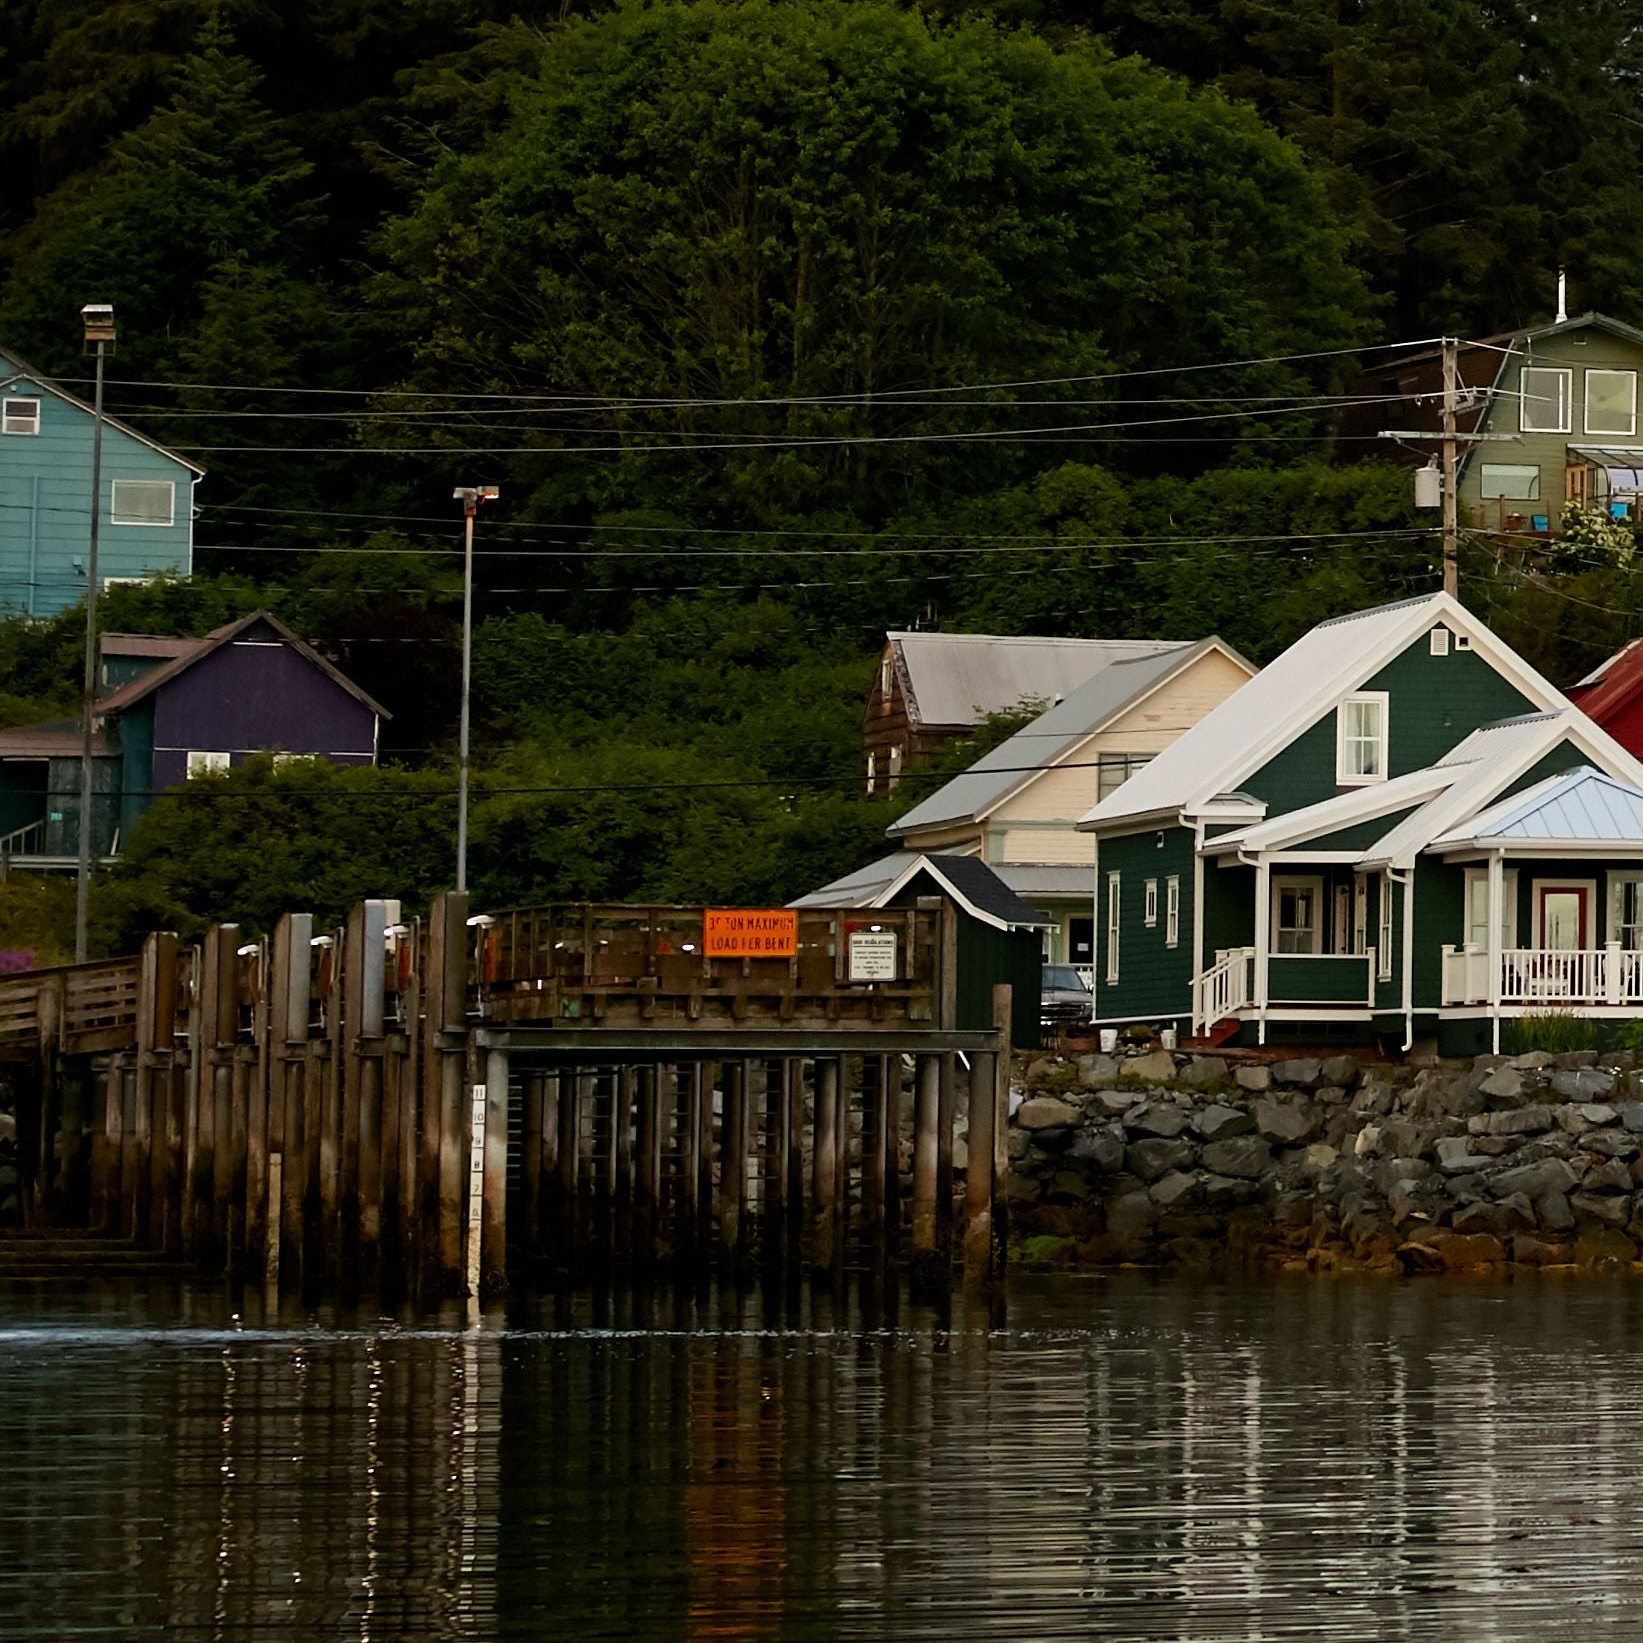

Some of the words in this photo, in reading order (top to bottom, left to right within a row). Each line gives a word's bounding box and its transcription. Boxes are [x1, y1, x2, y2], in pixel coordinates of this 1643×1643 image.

[725, 917, 744, 931] TON
[747, 917, 794, 931] MAXIMUM
[711, 936, 738, 950] LOAD
[741, 936, 761, 950] PER
[765, 936, 790, 950] BENT
